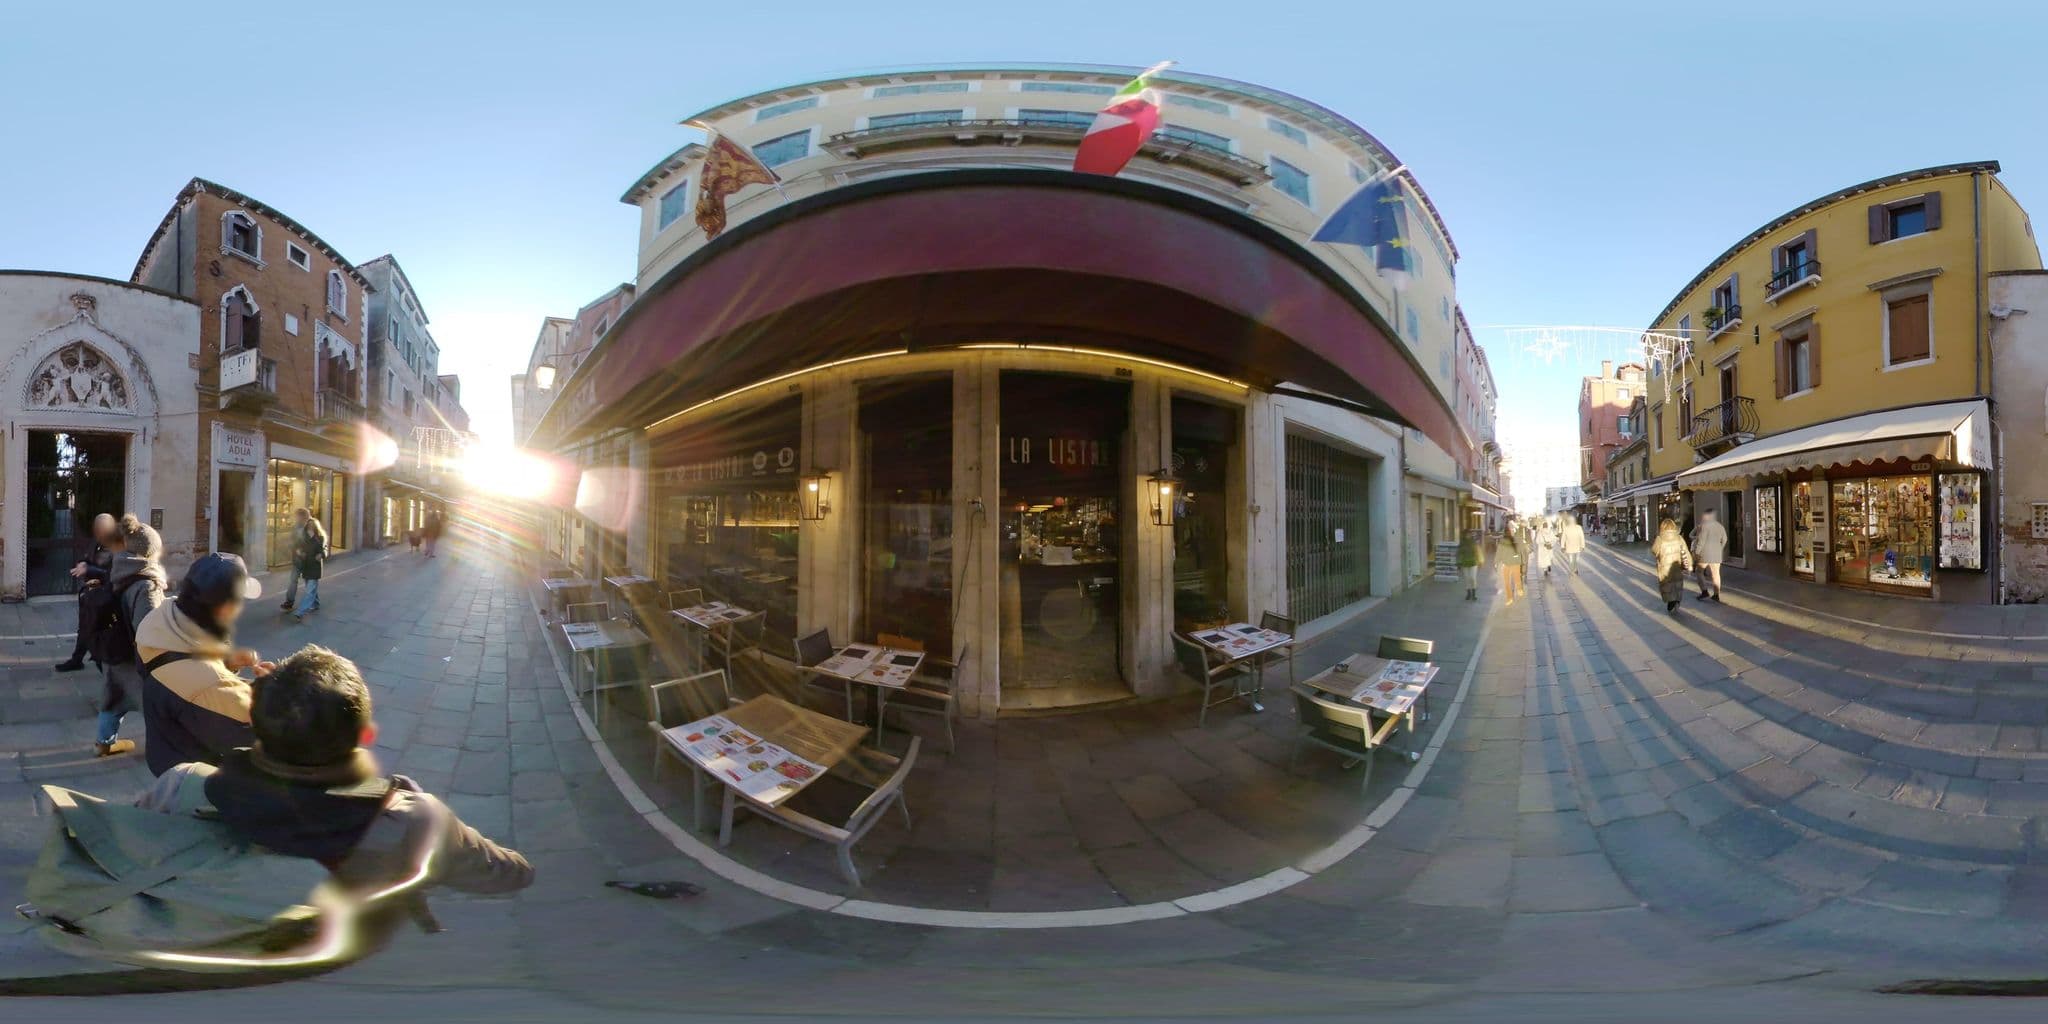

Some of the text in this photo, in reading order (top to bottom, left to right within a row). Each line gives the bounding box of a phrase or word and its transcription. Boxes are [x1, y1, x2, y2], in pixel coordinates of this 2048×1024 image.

[227, 433, 253, 447] HOTEL
[229, 445, 251, 456] ADUA
[1010, 437, 1030, 464] LA
